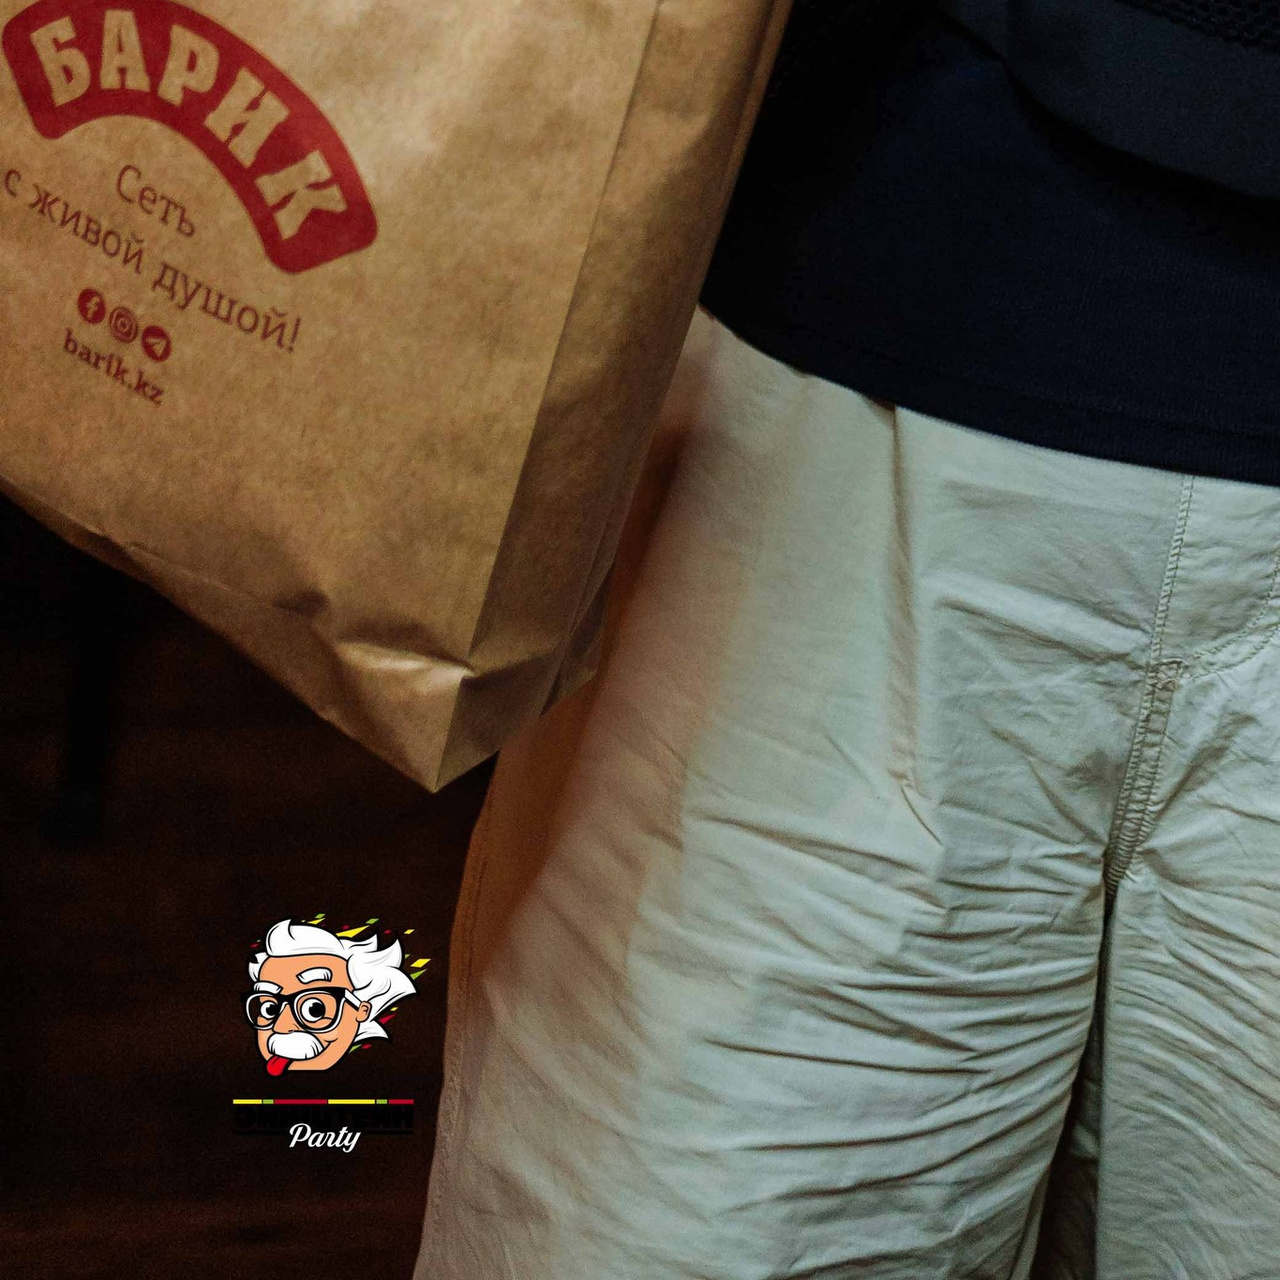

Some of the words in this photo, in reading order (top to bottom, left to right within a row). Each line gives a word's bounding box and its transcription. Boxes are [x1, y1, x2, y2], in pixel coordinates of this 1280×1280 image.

[30, 9, 347, 240] БАРИК
[4, 169, 22, 198] с
[29, 183, 145, 275] живой
[151, 260, 302, 353] душой!
[116, 164, 196, 238] Сеть
[64, 327, 164, 407] barik.kz
